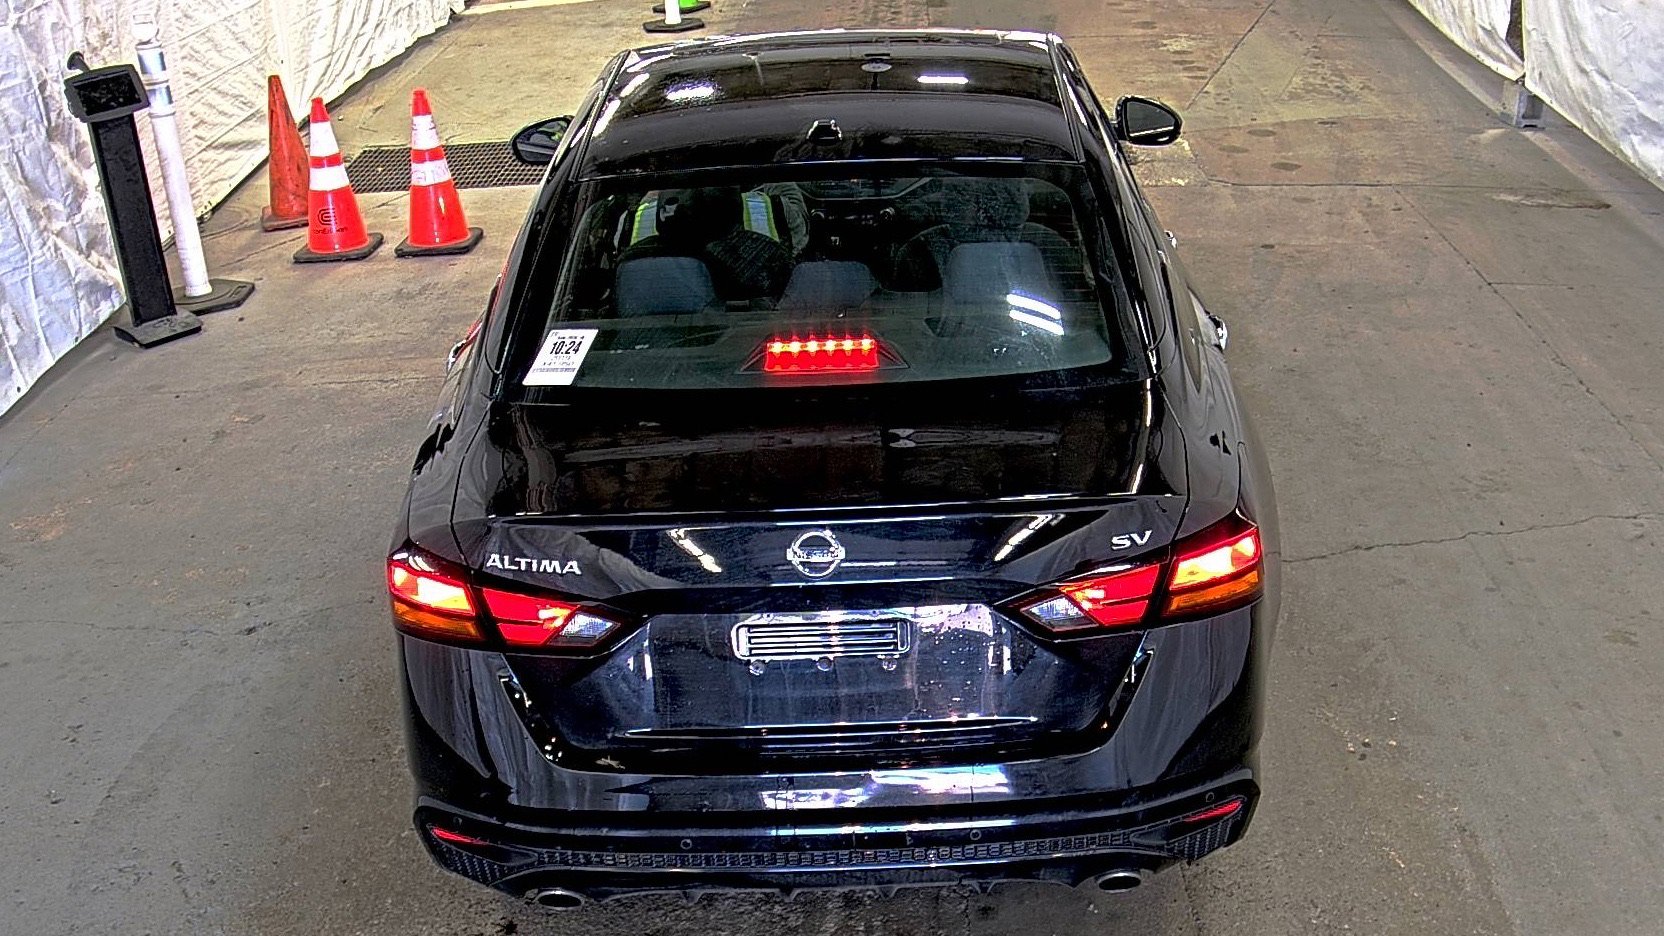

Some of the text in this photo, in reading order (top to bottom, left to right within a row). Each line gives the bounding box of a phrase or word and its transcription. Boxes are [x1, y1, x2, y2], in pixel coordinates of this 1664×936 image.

[549, 340, 583, 355] 10:24
[1111, 529, 1153, 550] SV
[486, 553, 582, 575] ALTIMA
